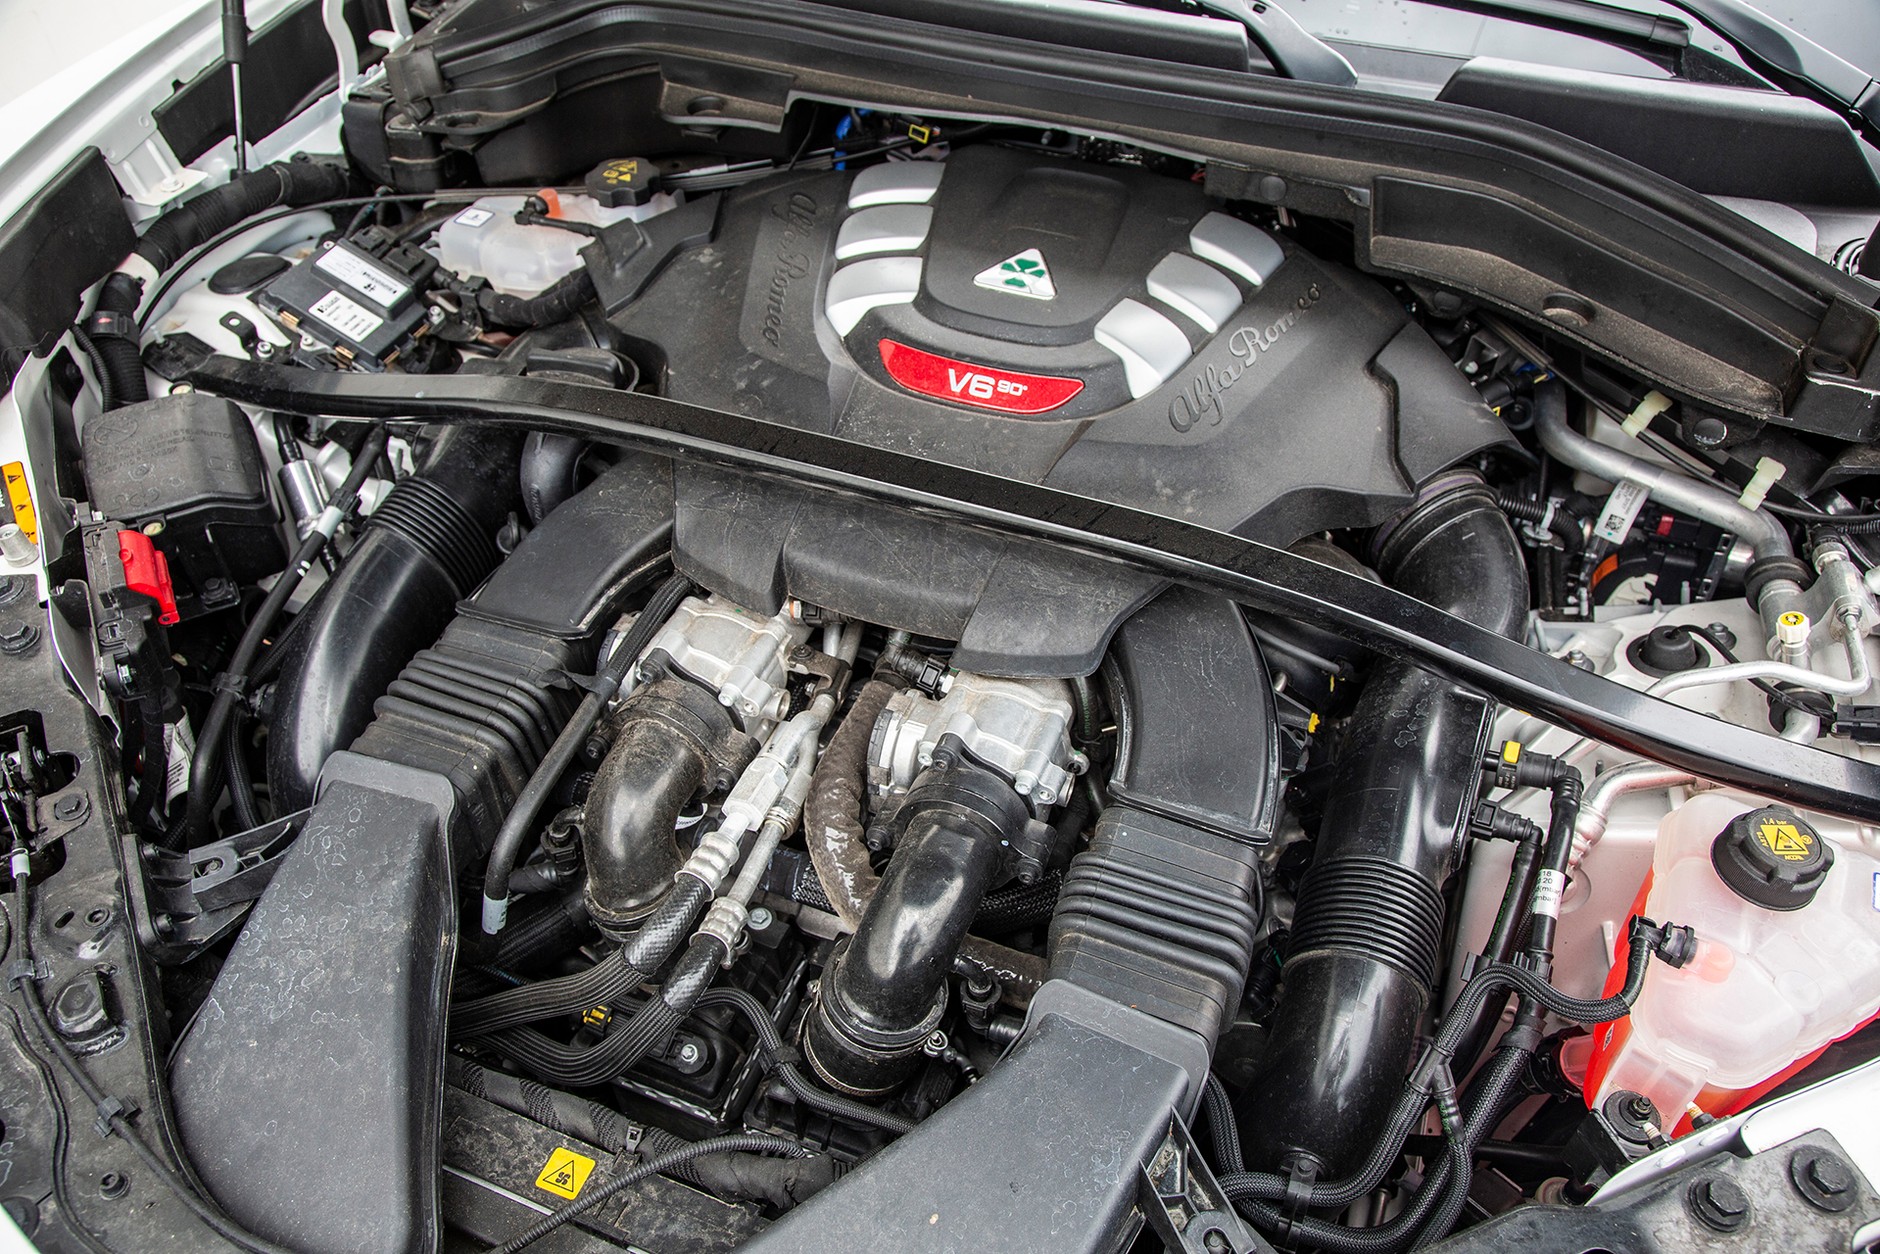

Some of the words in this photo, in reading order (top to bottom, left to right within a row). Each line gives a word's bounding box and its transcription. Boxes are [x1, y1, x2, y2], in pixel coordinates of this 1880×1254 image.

[763, 253, 811, 349] Romeo
[948, 368, 995, 399] V6
[1167, 362, 1242, 434] Alfa
[1228, 283, 1321, 368] Romeo
